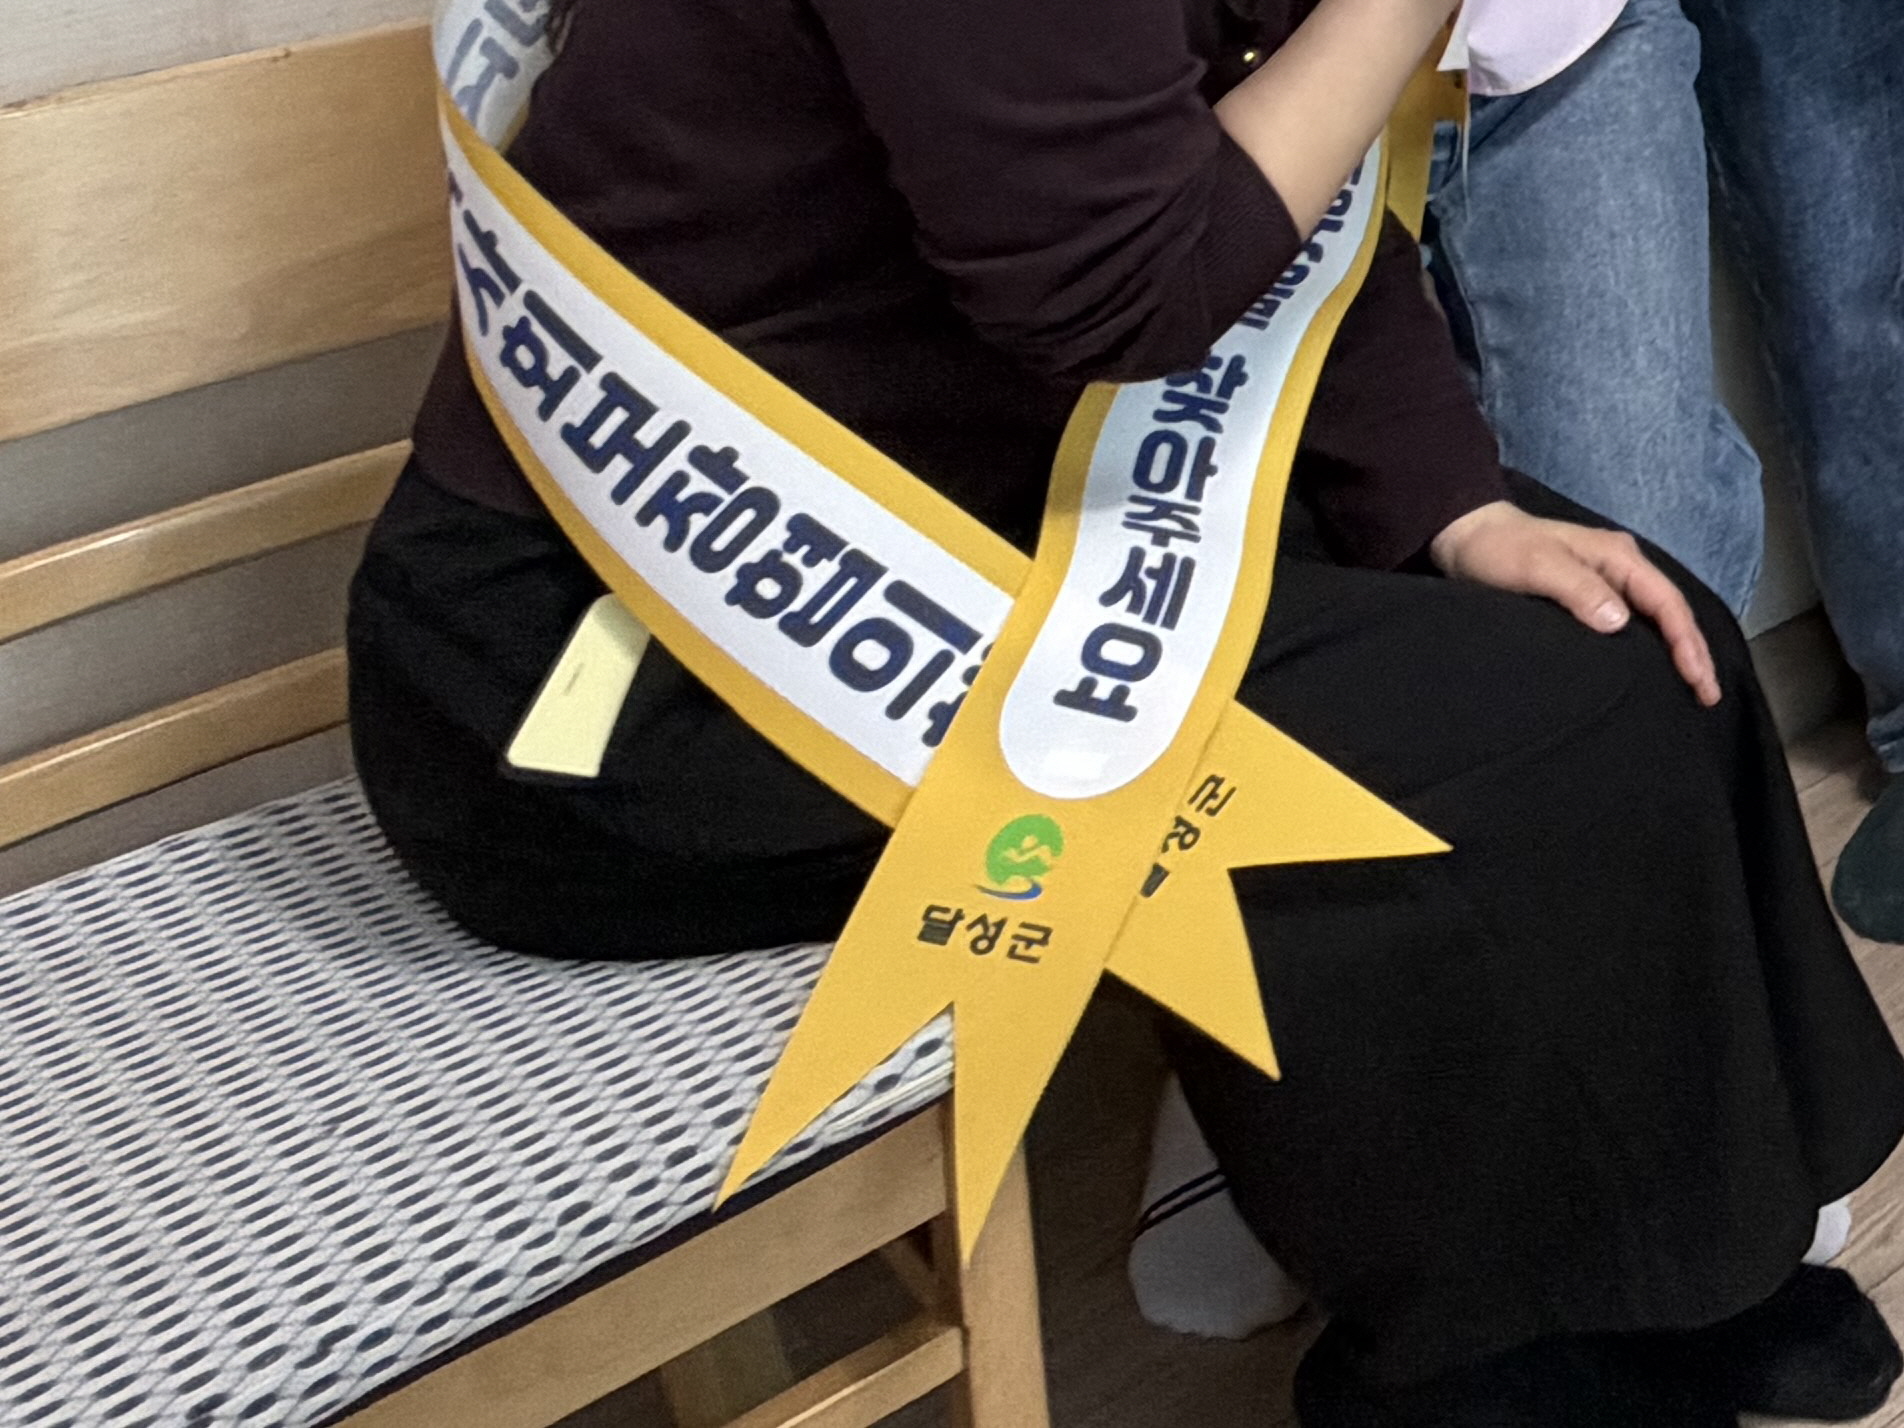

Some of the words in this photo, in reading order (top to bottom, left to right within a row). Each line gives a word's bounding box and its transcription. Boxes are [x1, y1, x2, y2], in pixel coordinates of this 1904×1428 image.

[446, 166, 1000, 750] 사회보장협의
[1055, 349, 1246, 725] 찾아주세요
[916, 904, 1057, 967] 달성군
